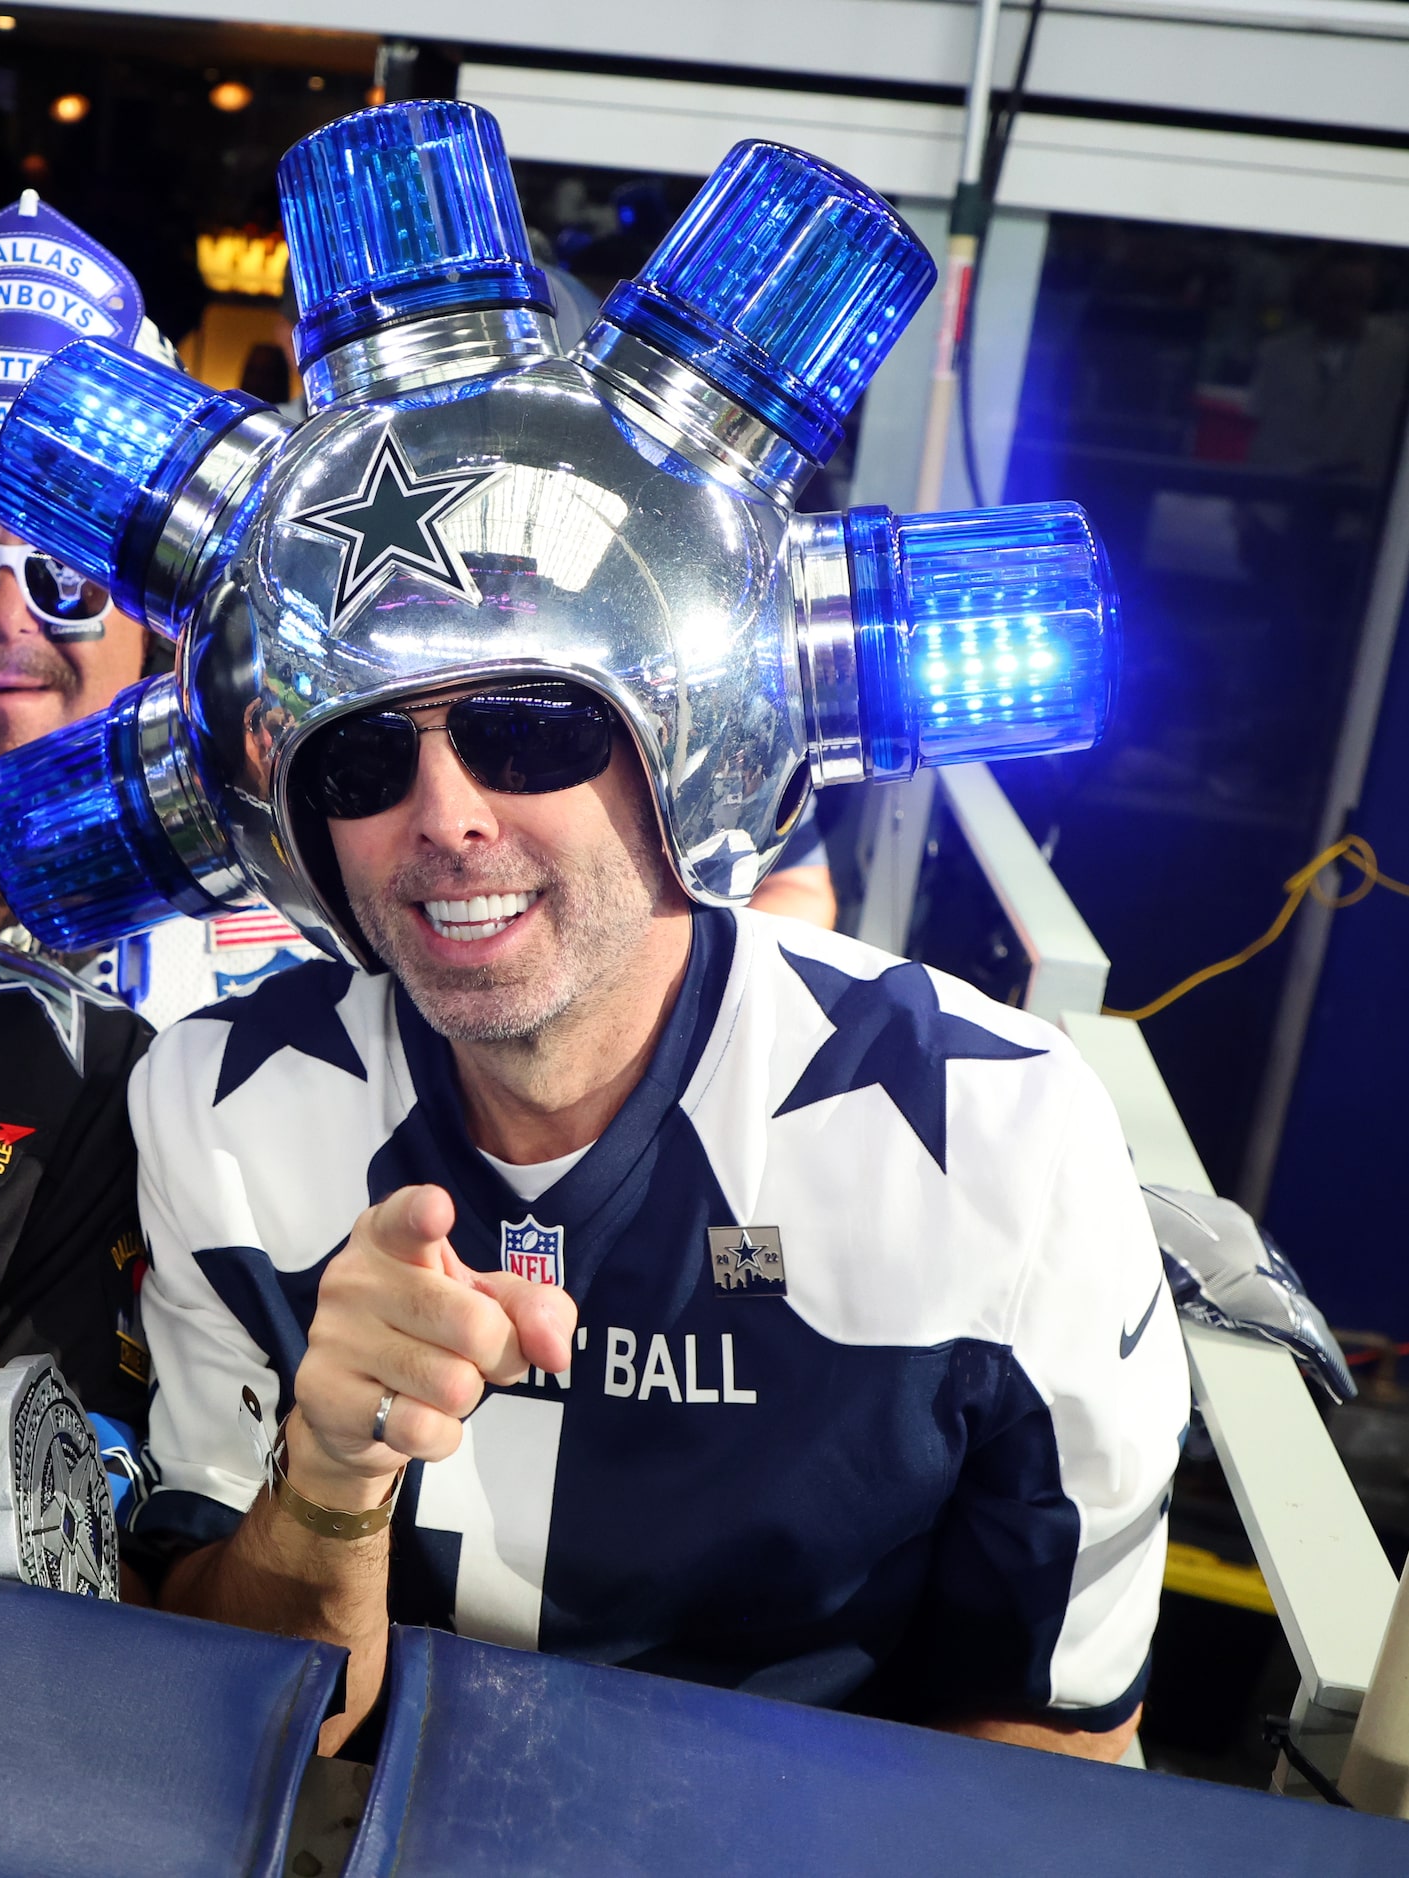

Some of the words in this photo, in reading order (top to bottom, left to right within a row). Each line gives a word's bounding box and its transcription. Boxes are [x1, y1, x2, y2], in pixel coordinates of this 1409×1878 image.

[509, 1253, 554, 1285] NFL
[716, 1254, 730, 1265] 20
[764, 1252, 779, 1263] 22
[604, 1326, 757, 1404] BALL
